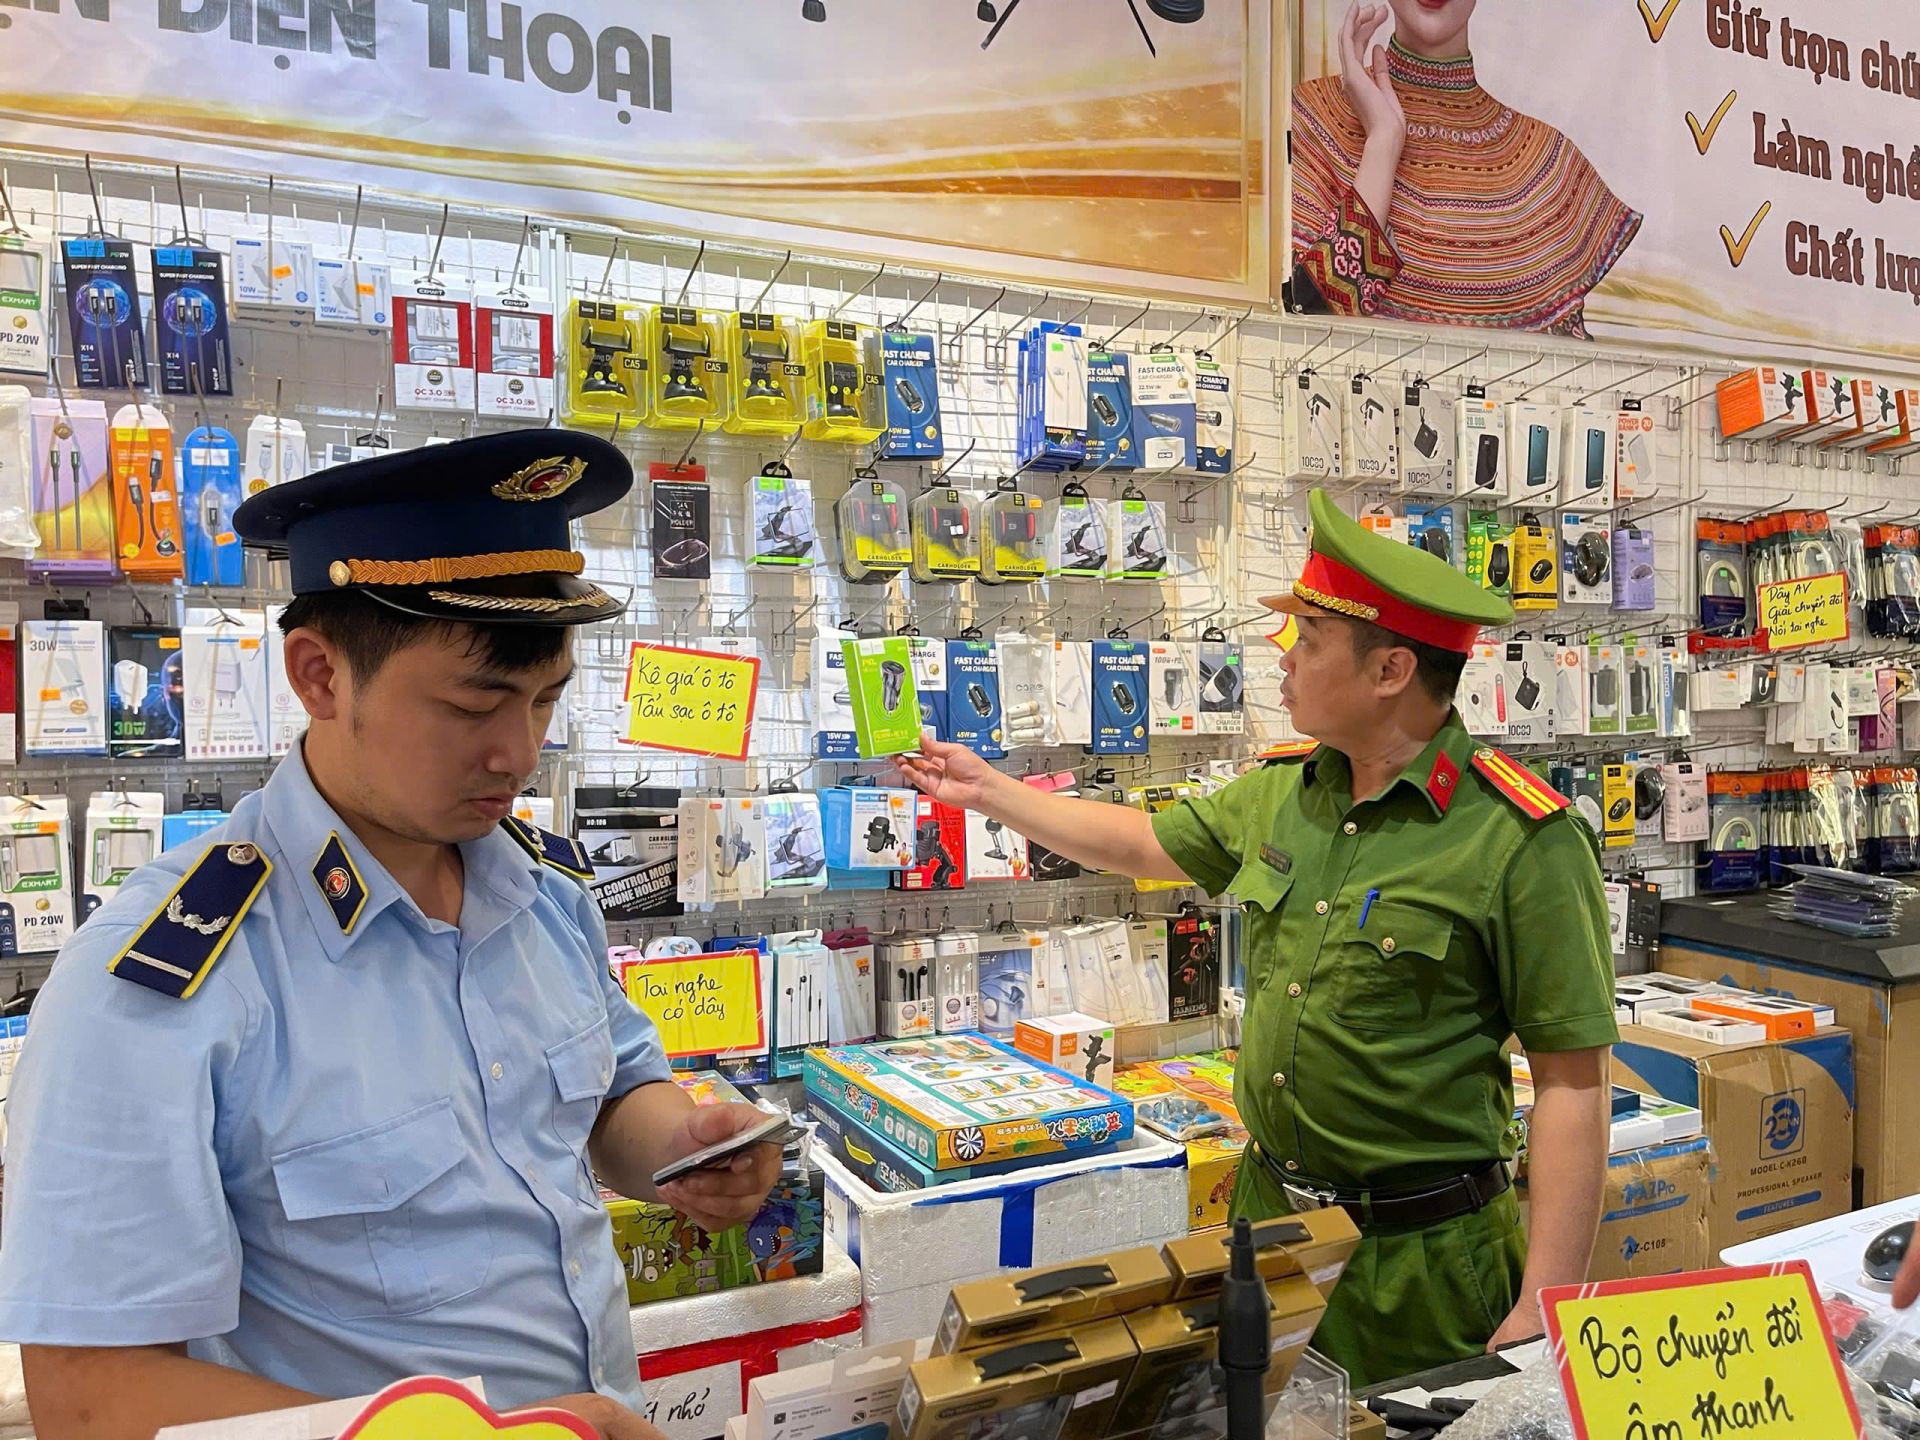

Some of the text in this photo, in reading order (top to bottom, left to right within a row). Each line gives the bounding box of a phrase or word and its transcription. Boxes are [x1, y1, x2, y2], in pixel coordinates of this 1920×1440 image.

[1706, 0, 1770, 60] Giữ
[1780, 17, 1850, 85] trọn
[411, 0, 673, 125] THOẠI
[1753, 111, 1832, 180] Làm
[1785, 220, 1864, 286] Chất
[16, 334, 40, 347] 20W
[80, 344, 94, 352] X14
[166, 352, 180, 360] X14
[624, 358, 641, 370] CA5
[705, 361, 722, 373] CA5
[784, 364, 800, 376] CA5
[1138, 365, 1186, 374] FAST CHARGE
[865, 374, 880, 386] CA5
[429, 389, 443, 397] 3.0
[1766, 582, 1812, 607] Dây AV
[1804, 618, 1829, 635] nghe
[29, 639, 57, 652] 30W
[954, 656, 998, 666] FAST CHARG
[1100, 656, 1117, 666] FAST
[665, 665, 700, 695] giá
[701, 667, 712, 688] ô
[718, 670, 736, 690] tô
[701, 701, 712, 721] ô
[716, 702, 737, 722] tô
[21, 879, 59, 889] EXMART
[603, 871, 650, 896] CONTROL
[601, 890, 635, 910] PHONE
[634, 875, 672, 898] HOLDER
[24, 914, 64, 927] PD 20W
[637, 973, 723, 1004] Tai nghe
[663, 996, 725, 1021] có dây
[1737, 1180, 1790, 1199] PROFESSIONAL
[1579, 1296, 1803, 1385] Bộ chuyển đổi
[1625, 1376, 1795, 1440] âm thanh
